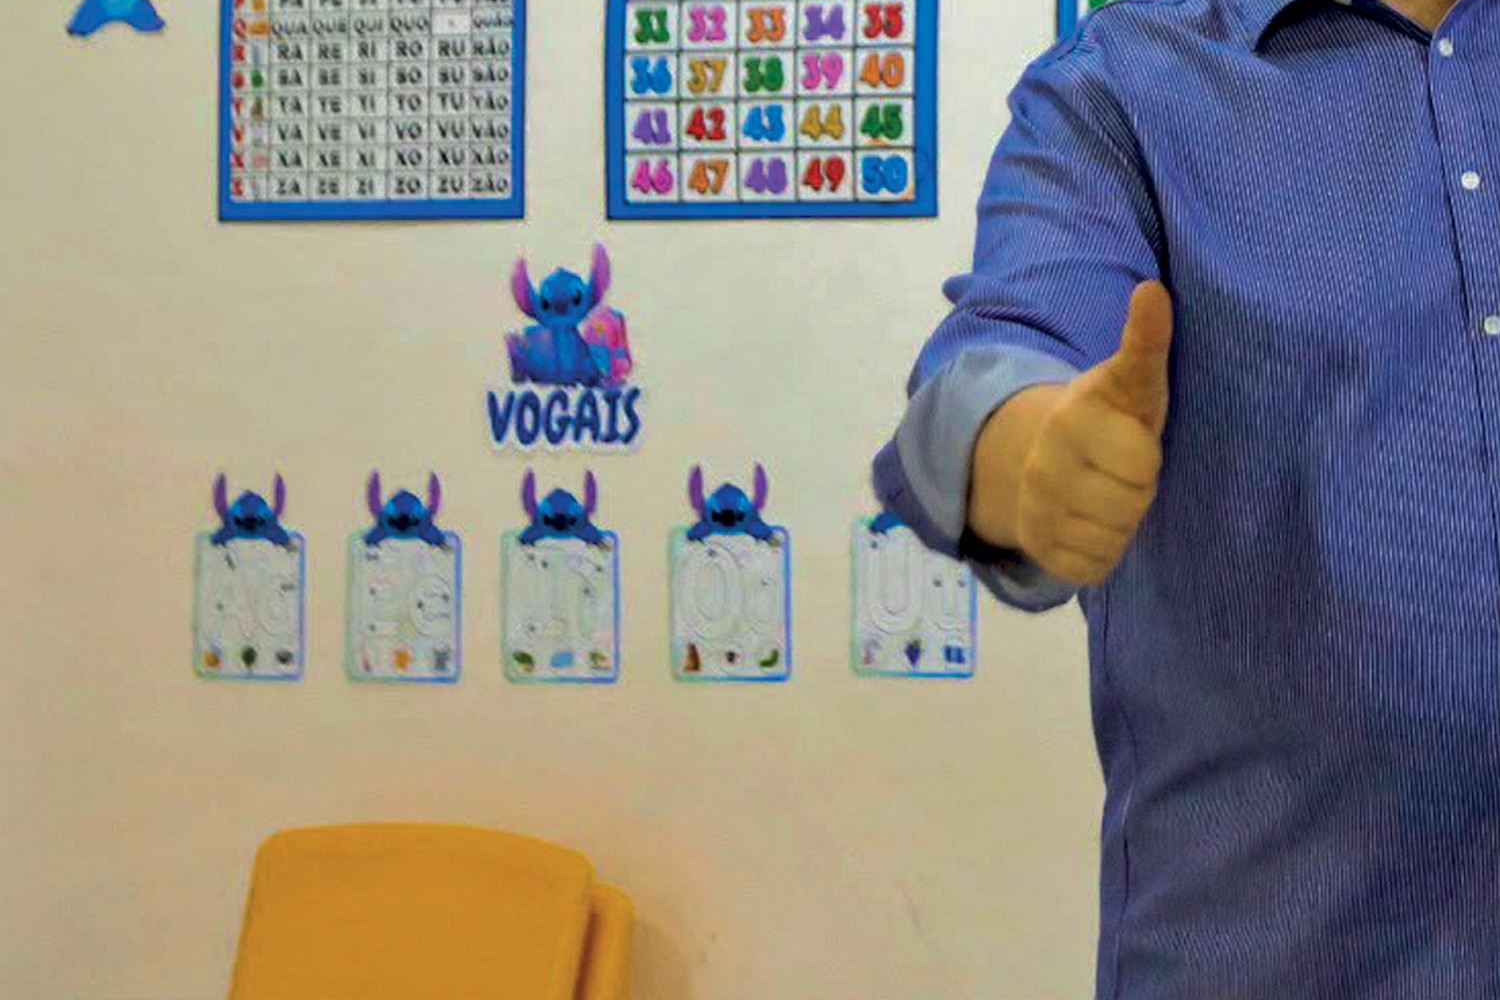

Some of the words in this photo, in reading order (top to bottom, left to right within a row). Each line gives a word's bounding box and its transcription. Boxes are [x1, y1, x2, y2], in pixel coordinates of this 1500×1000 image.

[634, 7, 671, 44] 31
[689, 8, 726, 42] 32
[746, 7, 786, 44] 33
[805, 7, 845, 41] 34
[863, 3, 904, 39] 35
[633, 57, 673, 96] 36
[688, 59, 727, 94] 37
[744, 56, 785, 93] 38
[803, 55, 843, 90] 39
[861, 54, 905, 89] 40
[687, 107, 726, 143] 42
[744, 105, 786, 143] 43
[803, 106, 844, 140] 44
[861, 103, 905, 141] 45
[633, 161, 673, 195] 46
[688, 160, 729, 195] 47
[803, 157, 846, 192] 49
[861, 155, 909, 195] 50
[487, 387, 641, 445] VOGAIS
